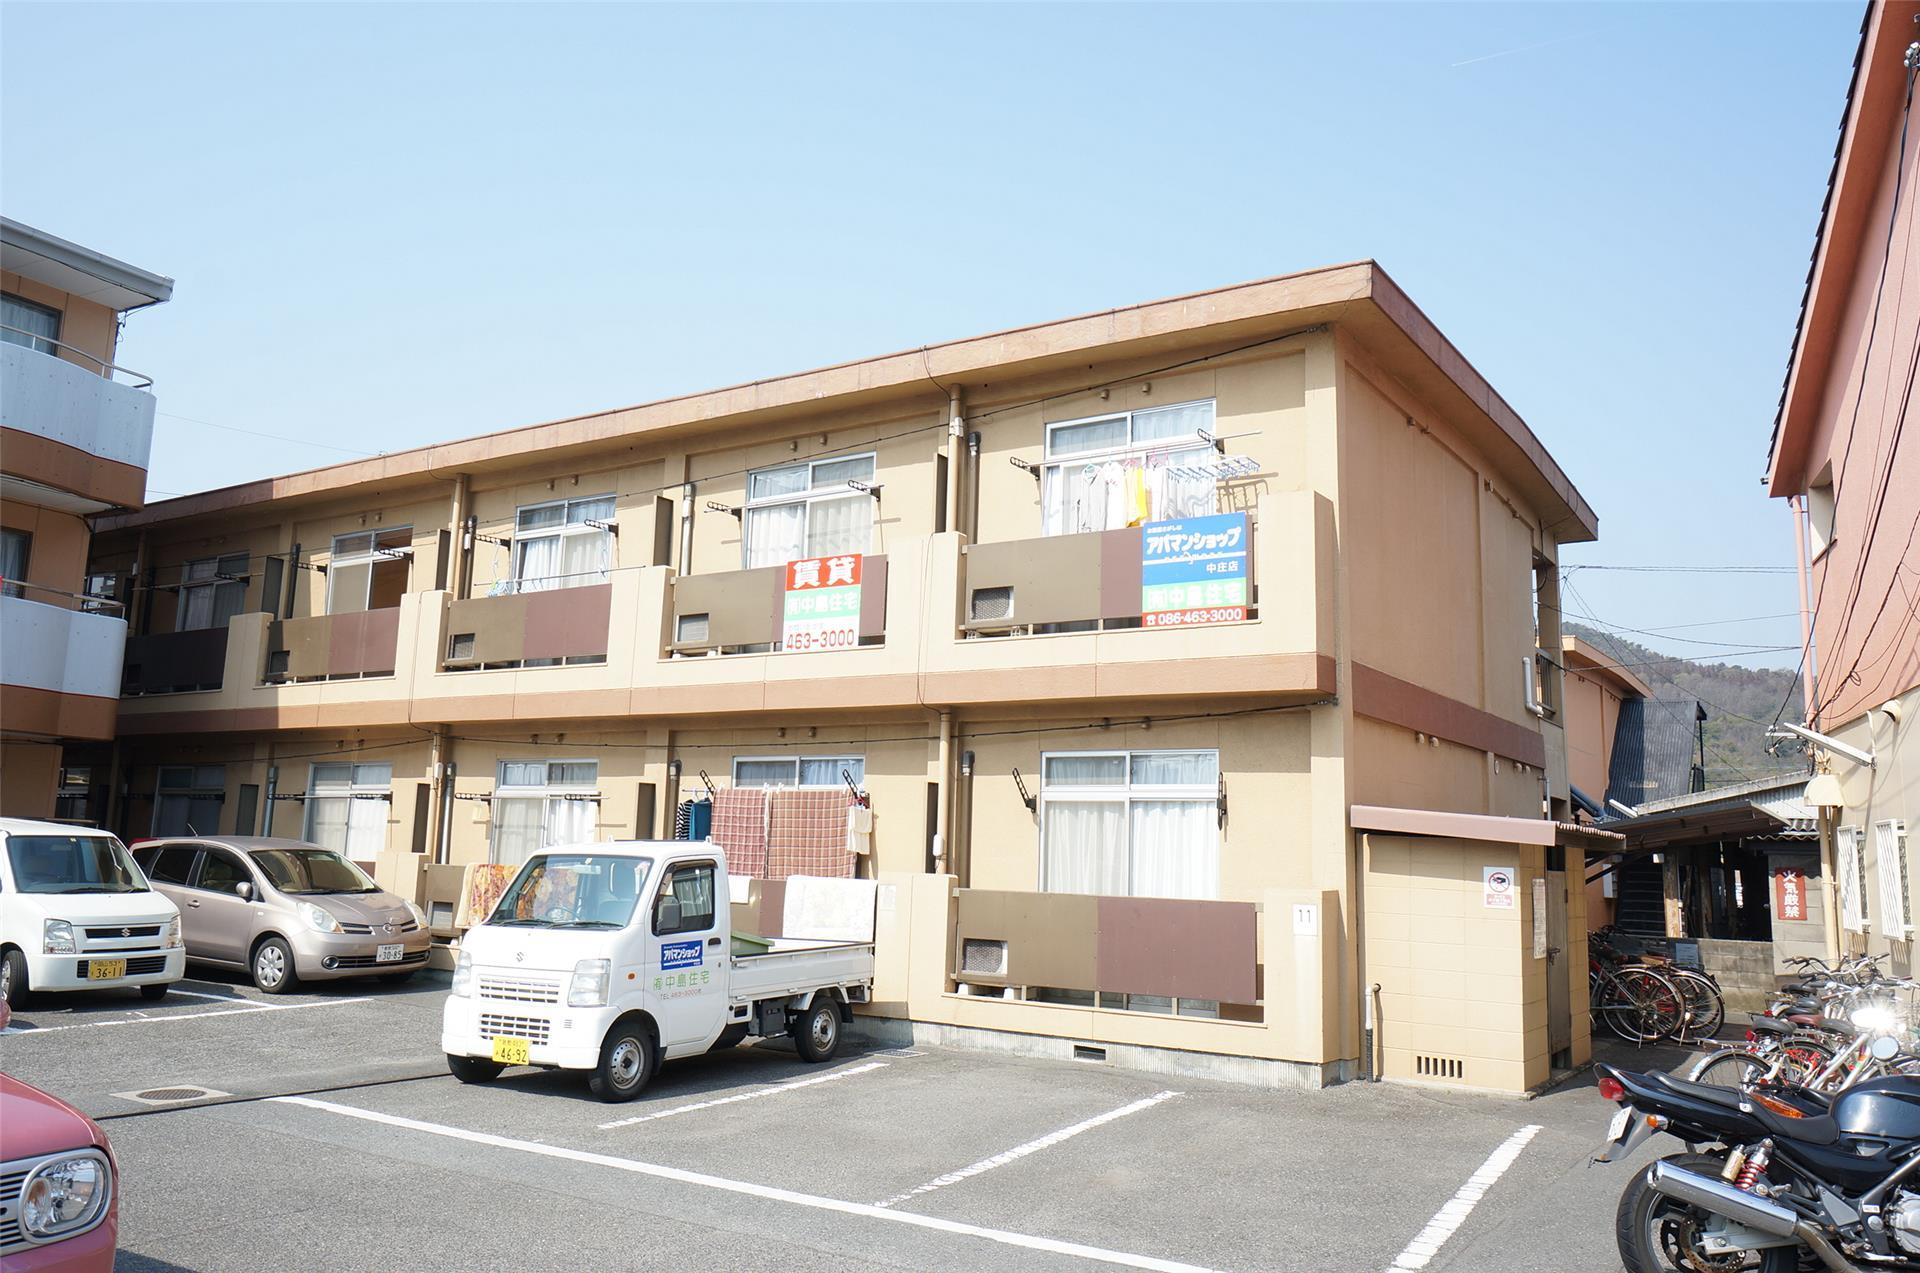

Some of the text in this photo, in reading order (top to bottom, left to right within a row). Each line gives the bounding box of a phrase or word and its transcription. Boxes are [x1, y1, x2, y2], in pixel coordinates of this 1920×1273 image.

[1146, 526, 1241, 555] アパマンショップ
[793, 556, 855, 589] 賃貸
[1206, 561, 1238, 573] 中庄店
[786, 629, 855, 650] 463-3000
[96, 967, 123, 978] 36-11
[500, 1047, 527, 1063] 46-92
